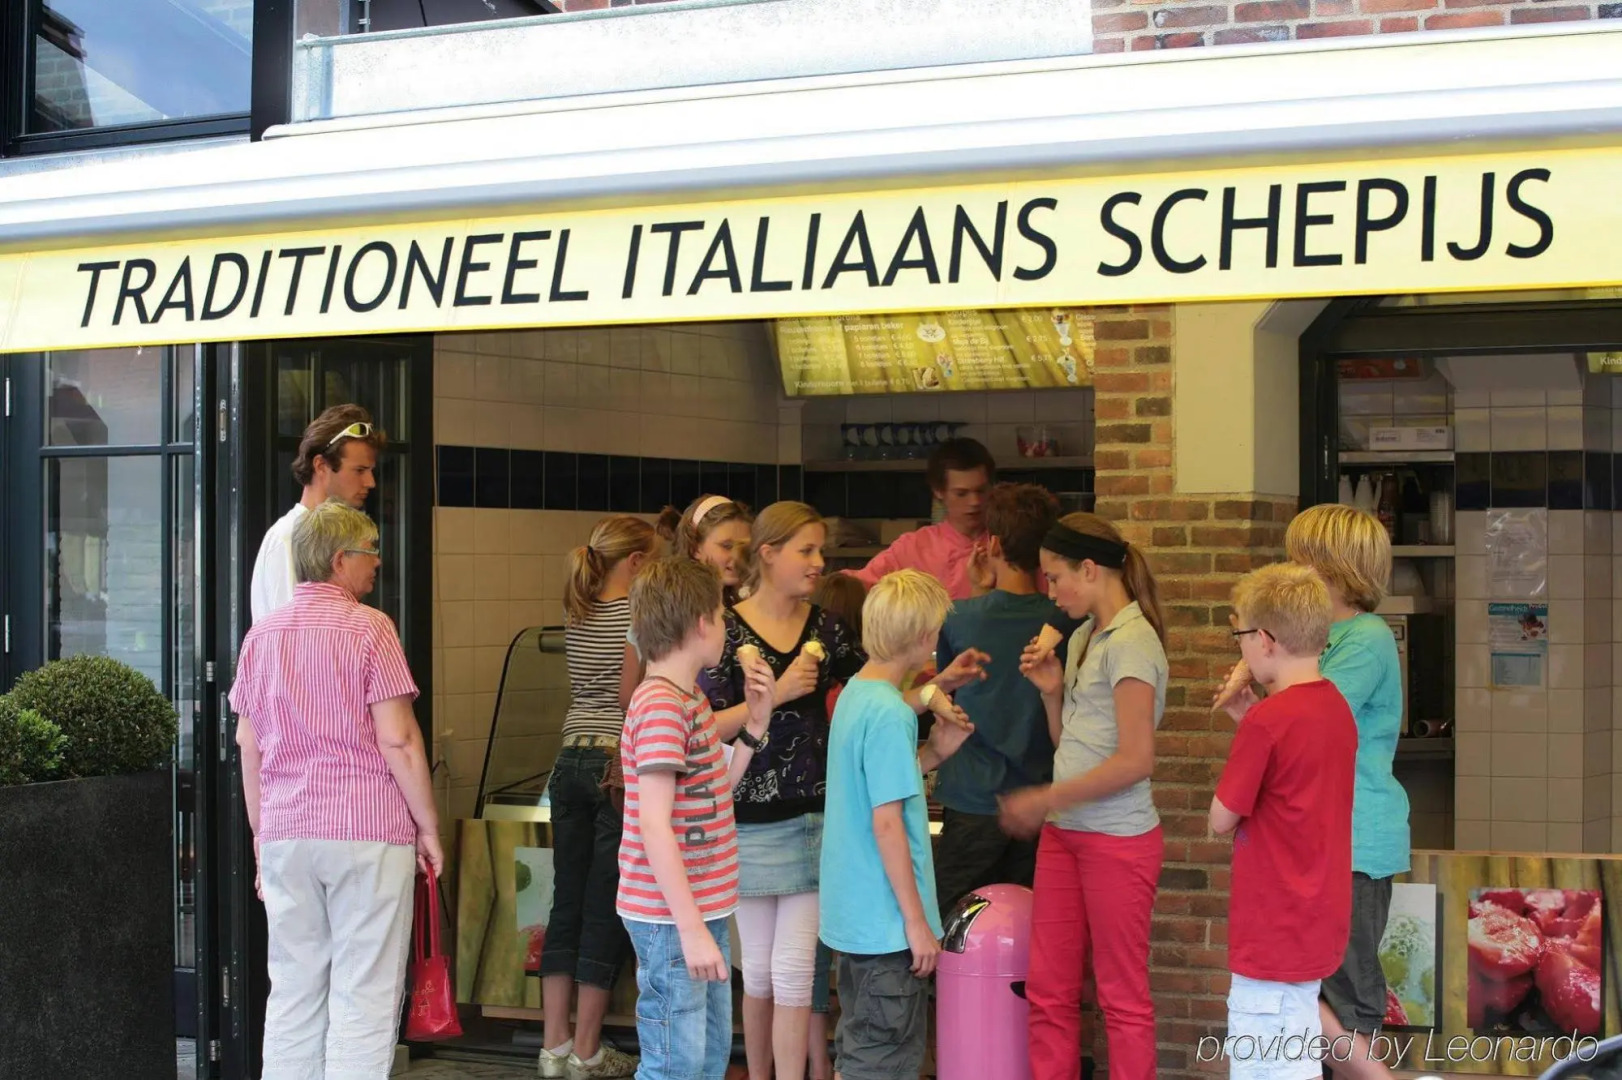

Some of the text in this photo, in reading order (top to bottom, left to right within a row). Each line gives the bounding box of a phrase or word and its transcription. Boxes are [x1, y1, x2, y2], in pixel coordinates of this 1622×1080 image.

[77, 168, 1554, 328] TRADITIONEEL ITALIAANS SCHEPIJS
